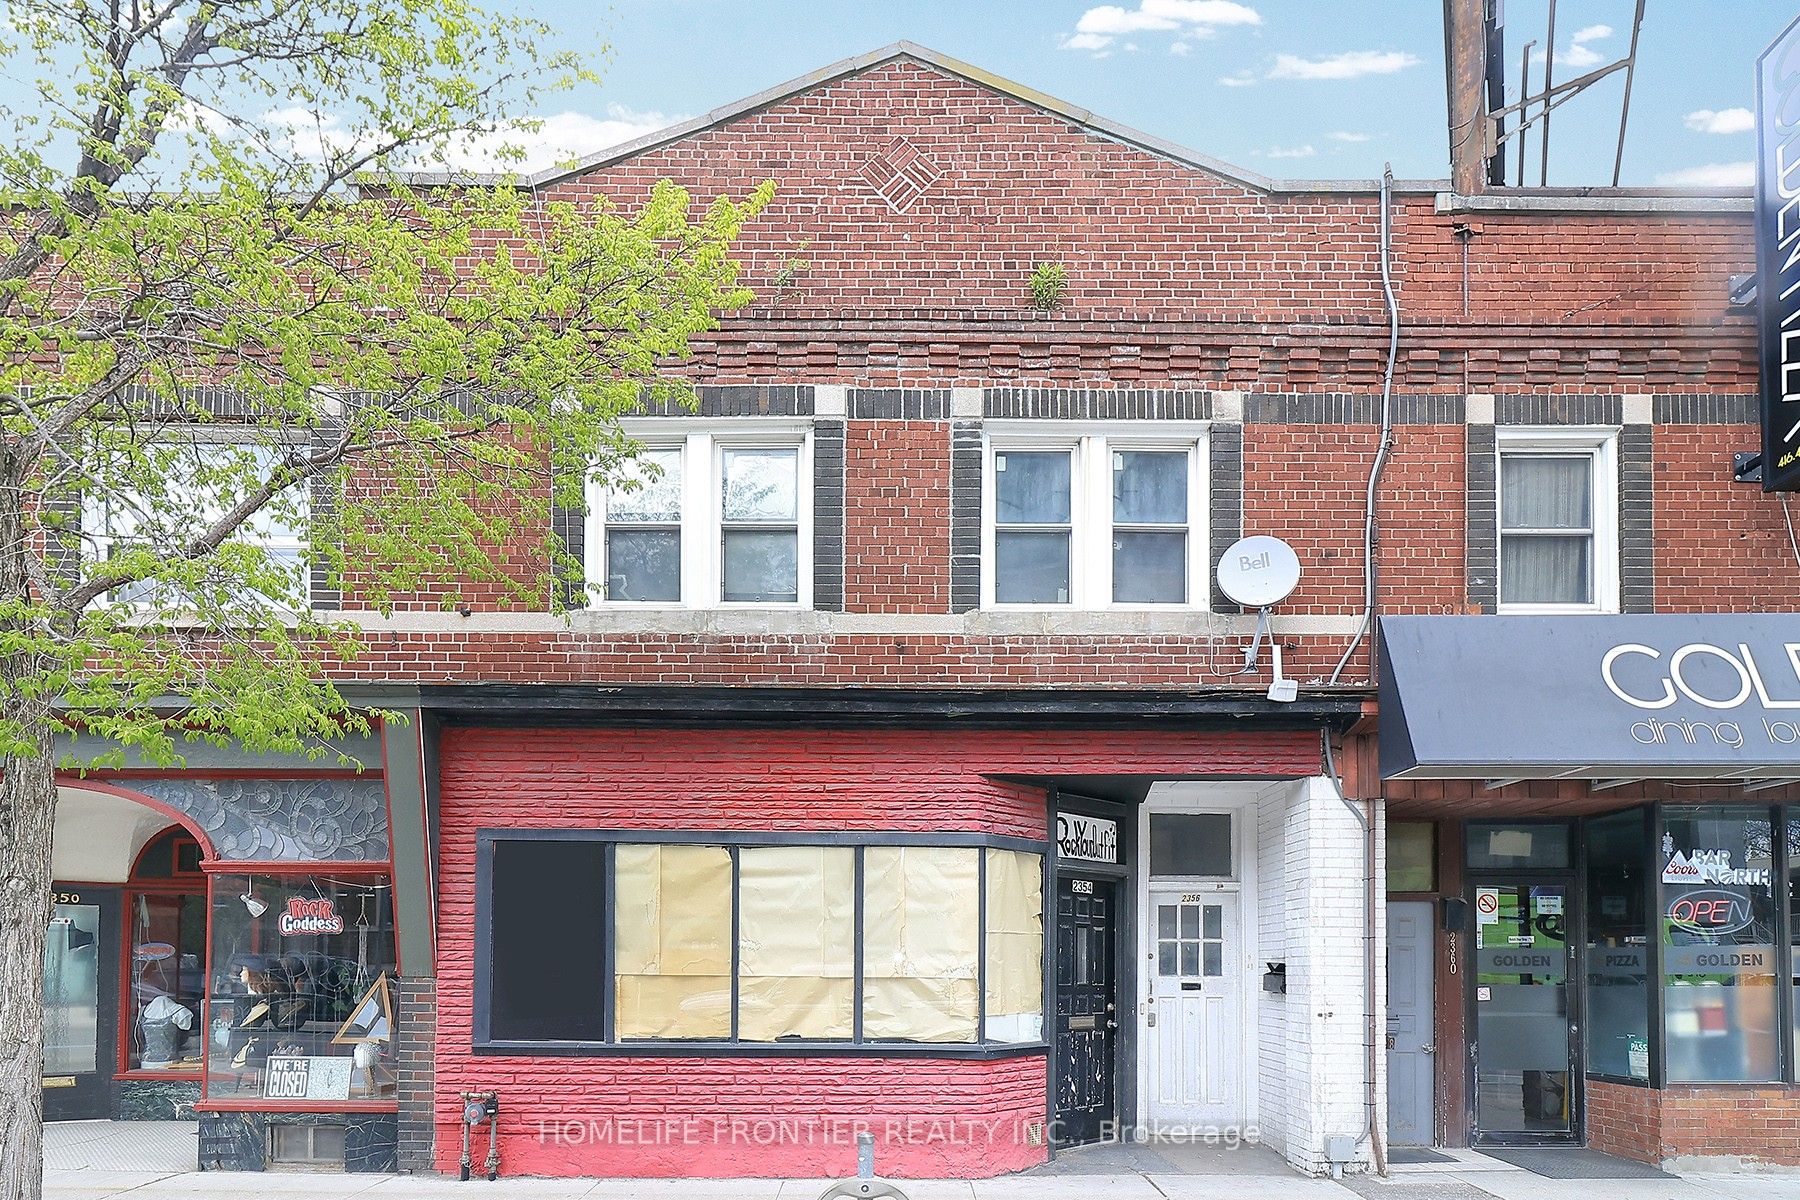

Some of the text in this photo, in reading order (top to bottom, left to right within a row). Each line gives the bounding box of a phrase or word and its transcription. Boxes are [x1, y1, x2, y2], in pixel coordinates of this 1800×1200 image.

[1239, 551, 1271, 571] Bell
[1630, 717, 1800, 749] dining lo
[1694, 849, 1732, 867] BAR
[1666, 861, 1699, 875] Coors
[1073, 881, 1092, 894] 2354
[1671, 900, 1751, 923] OPEN
[281, 914, 339, 933] Goddess
[1449, 931, 1457, 975] 2360
[1493, 955, 1550, 967] GOLDEN
[1606, 954, 1639, 967] PIZZA
[1696, 953, 1763, 967] GOLDEN
[1630, 1042, 1648, 1052] PASS
[271, 1059, 309, 1071] WE'RE
[268, 1070, 308, 1097] CLOSED
